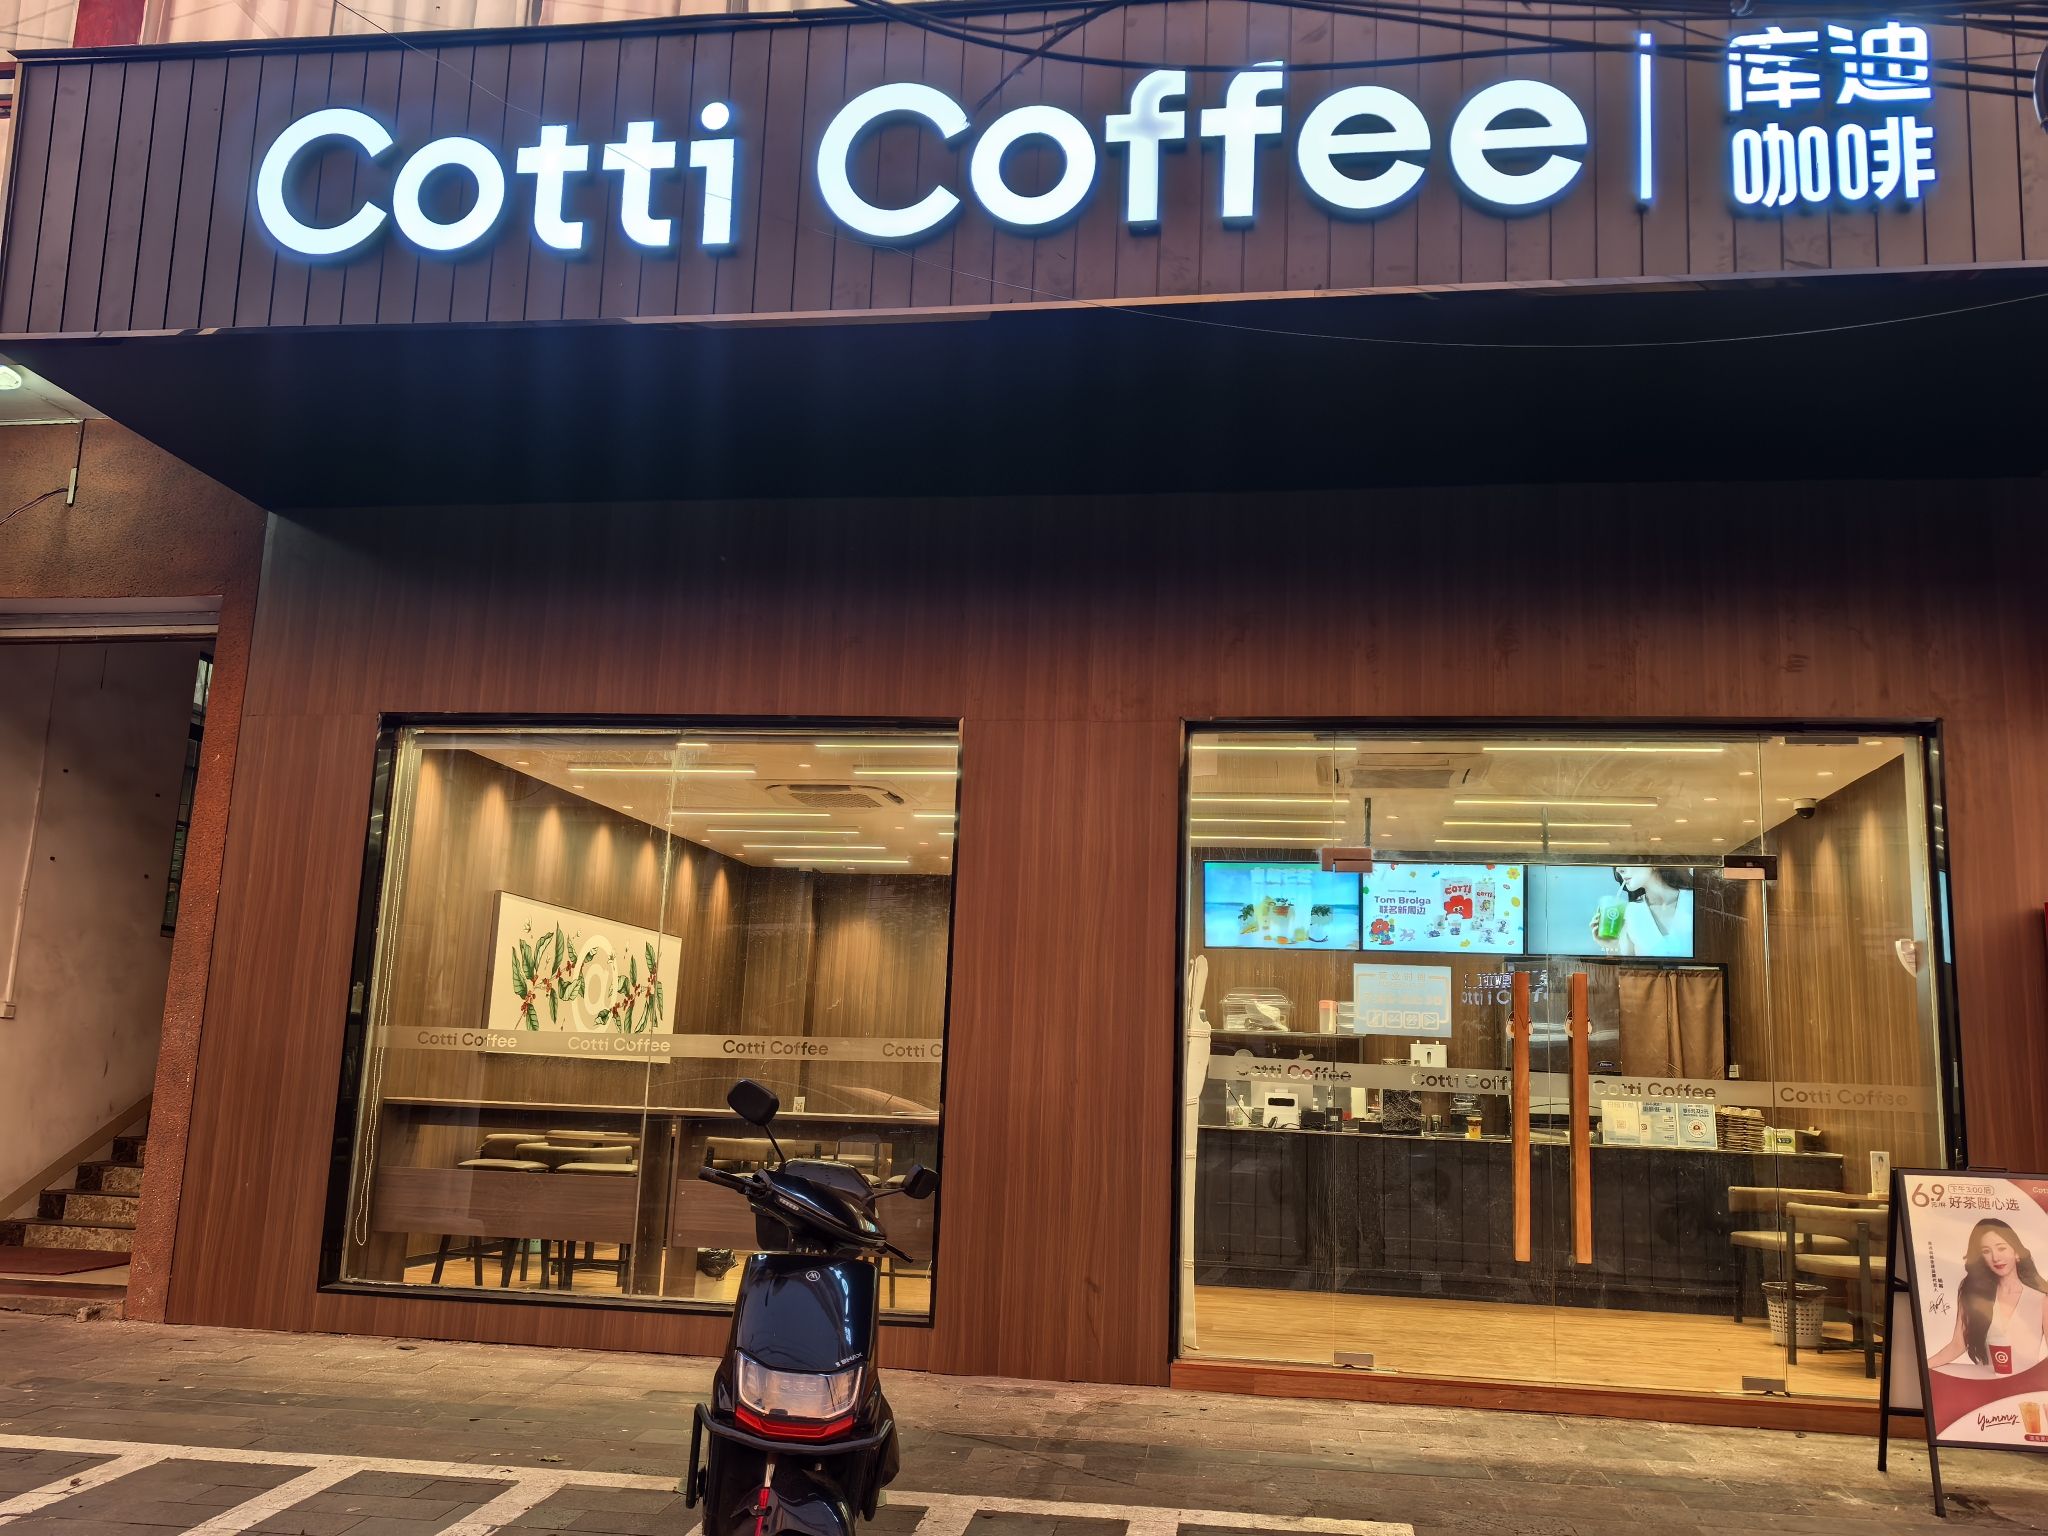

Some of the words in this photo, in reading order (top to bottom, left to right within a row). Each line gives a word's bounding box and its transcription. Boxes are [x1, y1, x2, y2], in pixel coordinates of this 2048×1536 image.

[1727, 21, 1932, 112] 库迪
[257, 101, 736, 255] Cotti
[816, 60, 1588, 238] Coffee
[1731, 115, 1936, 208] 咖啡
[1374, 896, 1396, 904] Tom
[1398, 896, 1431, 906] Brolga
[1379, 905, 1426, 915] 联名新周边
[417, 1031, 458, 1046] Cotti
[462, 1032, 518, 1048] Coffee
[568, 1036, 609, 1051] Cotti
[613, 1038, 671, 1053] Coffee
[722, 1039, 765, 1055] Cotti
[770, 1040, 829, 1056] Coffee
[882, 1042, 925, 1058] Cotti
[1287, 1064, 1352, 1081] Coffee
[1411, 1071, 1459, 1088] Cotti
[1592, 1079, 1642, 1098] Cotti
[1647, 1082, 1717, 1100] Coffee
[1780, 1087, 1831, 1105] Cotti
[1837, 1089, 1909, 1107] Coffee
[1911, 1183, 1945, 1208] 6.9
[1948, 1196, 2020, 1211] 好茶随心选
[1977, 1413, 2019, 1432] Yummy
